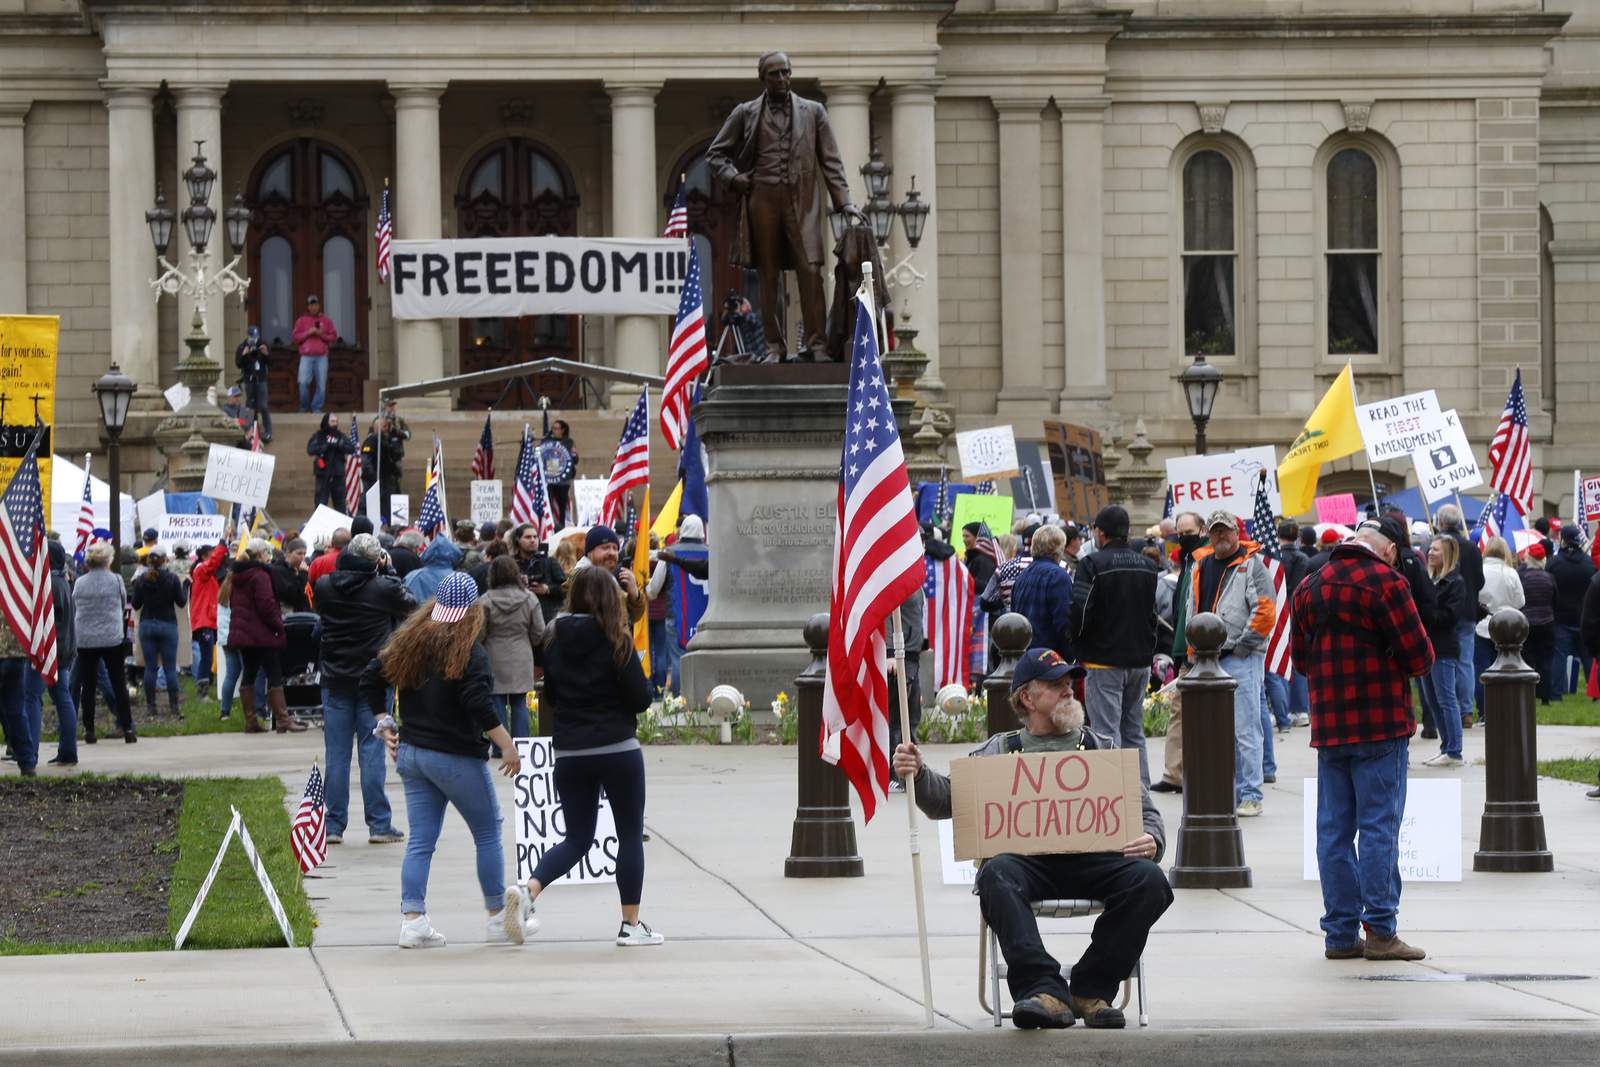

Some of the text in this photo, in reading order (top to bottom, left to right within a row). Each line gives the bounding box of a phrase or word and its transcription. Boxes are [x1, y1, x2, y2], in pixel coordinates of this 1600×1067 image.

[393, 249, 686, 296] FREEEDOM!!!
[14, 347, 30, 362] your
[0, 364, 22, 379] gain!
[1369, 398, 1427, 422] READ THE
[1385, 416, 1421, 436] FIRST
[1374, 429, 1445, 456] AMENDMENT
[215, 448, 236, 468] WE
[214, 471, 263, 498] PEOPLE
[1429, 463, 1476, 489] US NOW
[1173, 475, 1235, 505] FREE
[752, 503, 810, 521] AUSTIN
[515, 741, 555, 769] FOL
[1012, 754, 1090, 797] NO
[984, 796, 1124, 840] DICTATORS
